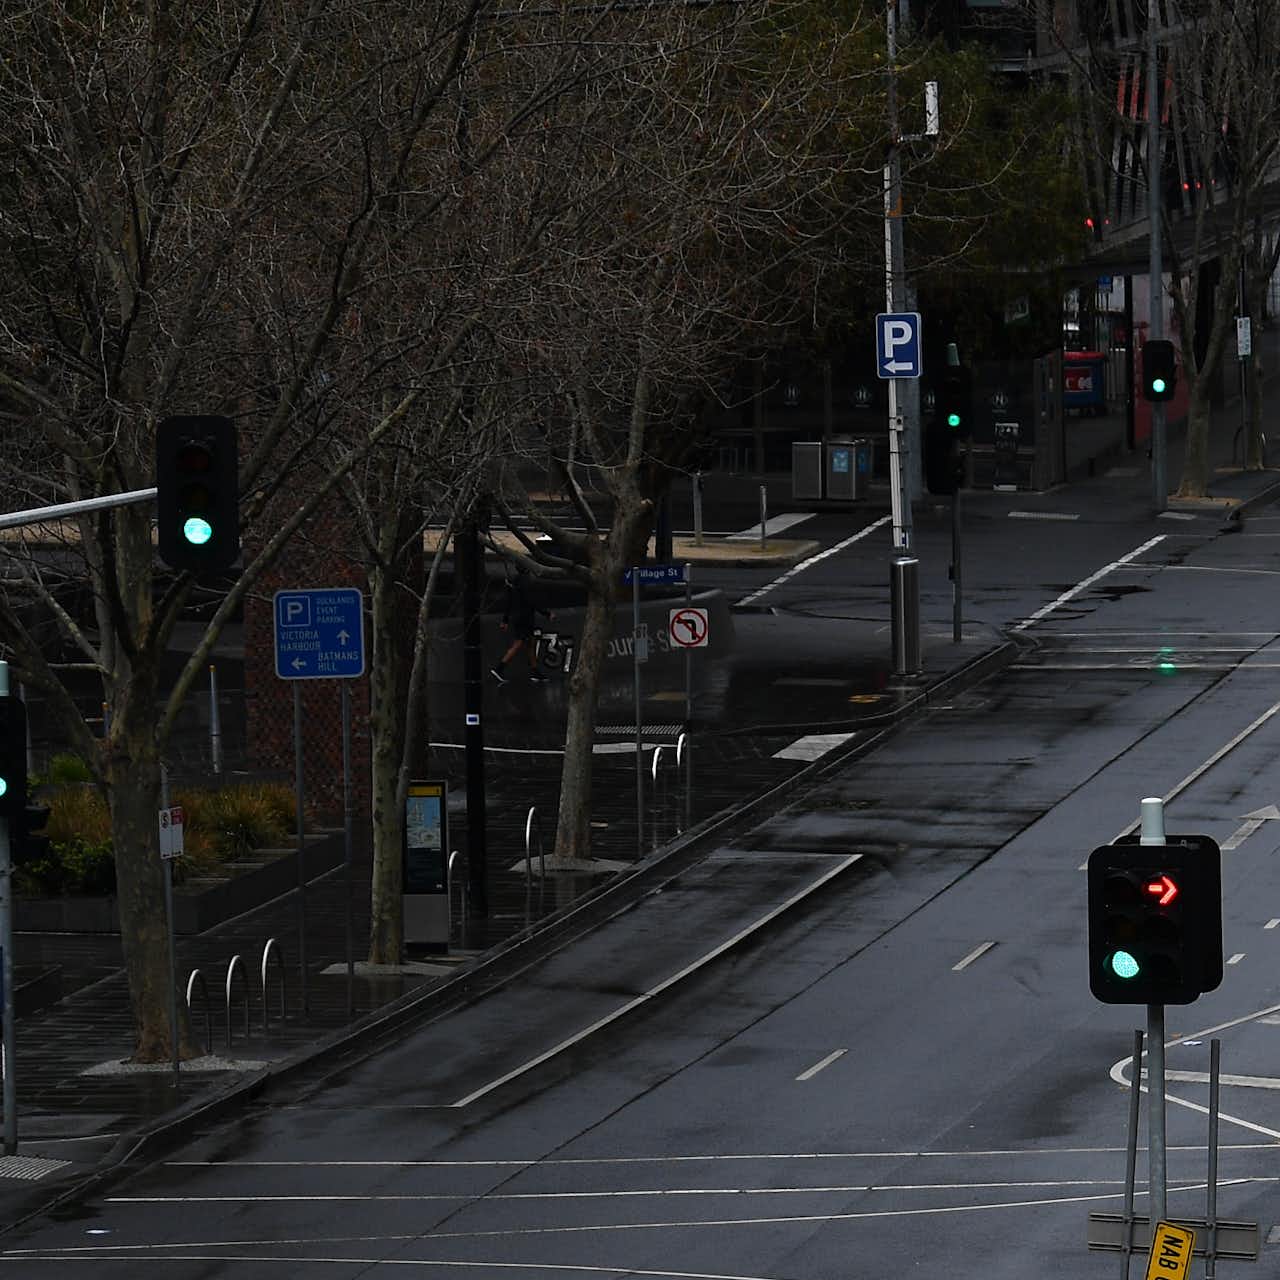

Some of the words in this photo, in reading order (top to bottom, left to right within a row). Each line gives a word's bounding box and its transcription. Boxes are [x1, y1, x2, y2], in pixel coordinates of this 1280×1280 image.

[884, 321, 912, 358] P
[632, 568, 665, 578] illage
[667, 567, 679, 577] St
[287, 602, 303, 622] P
[280, 630, 320, 641] VICTORIA
[280, 641, 321, 652] HARBOUR
[318, 651, 359, 661] BATMANS
[1158, 1233, 1184, 1271] NAB
